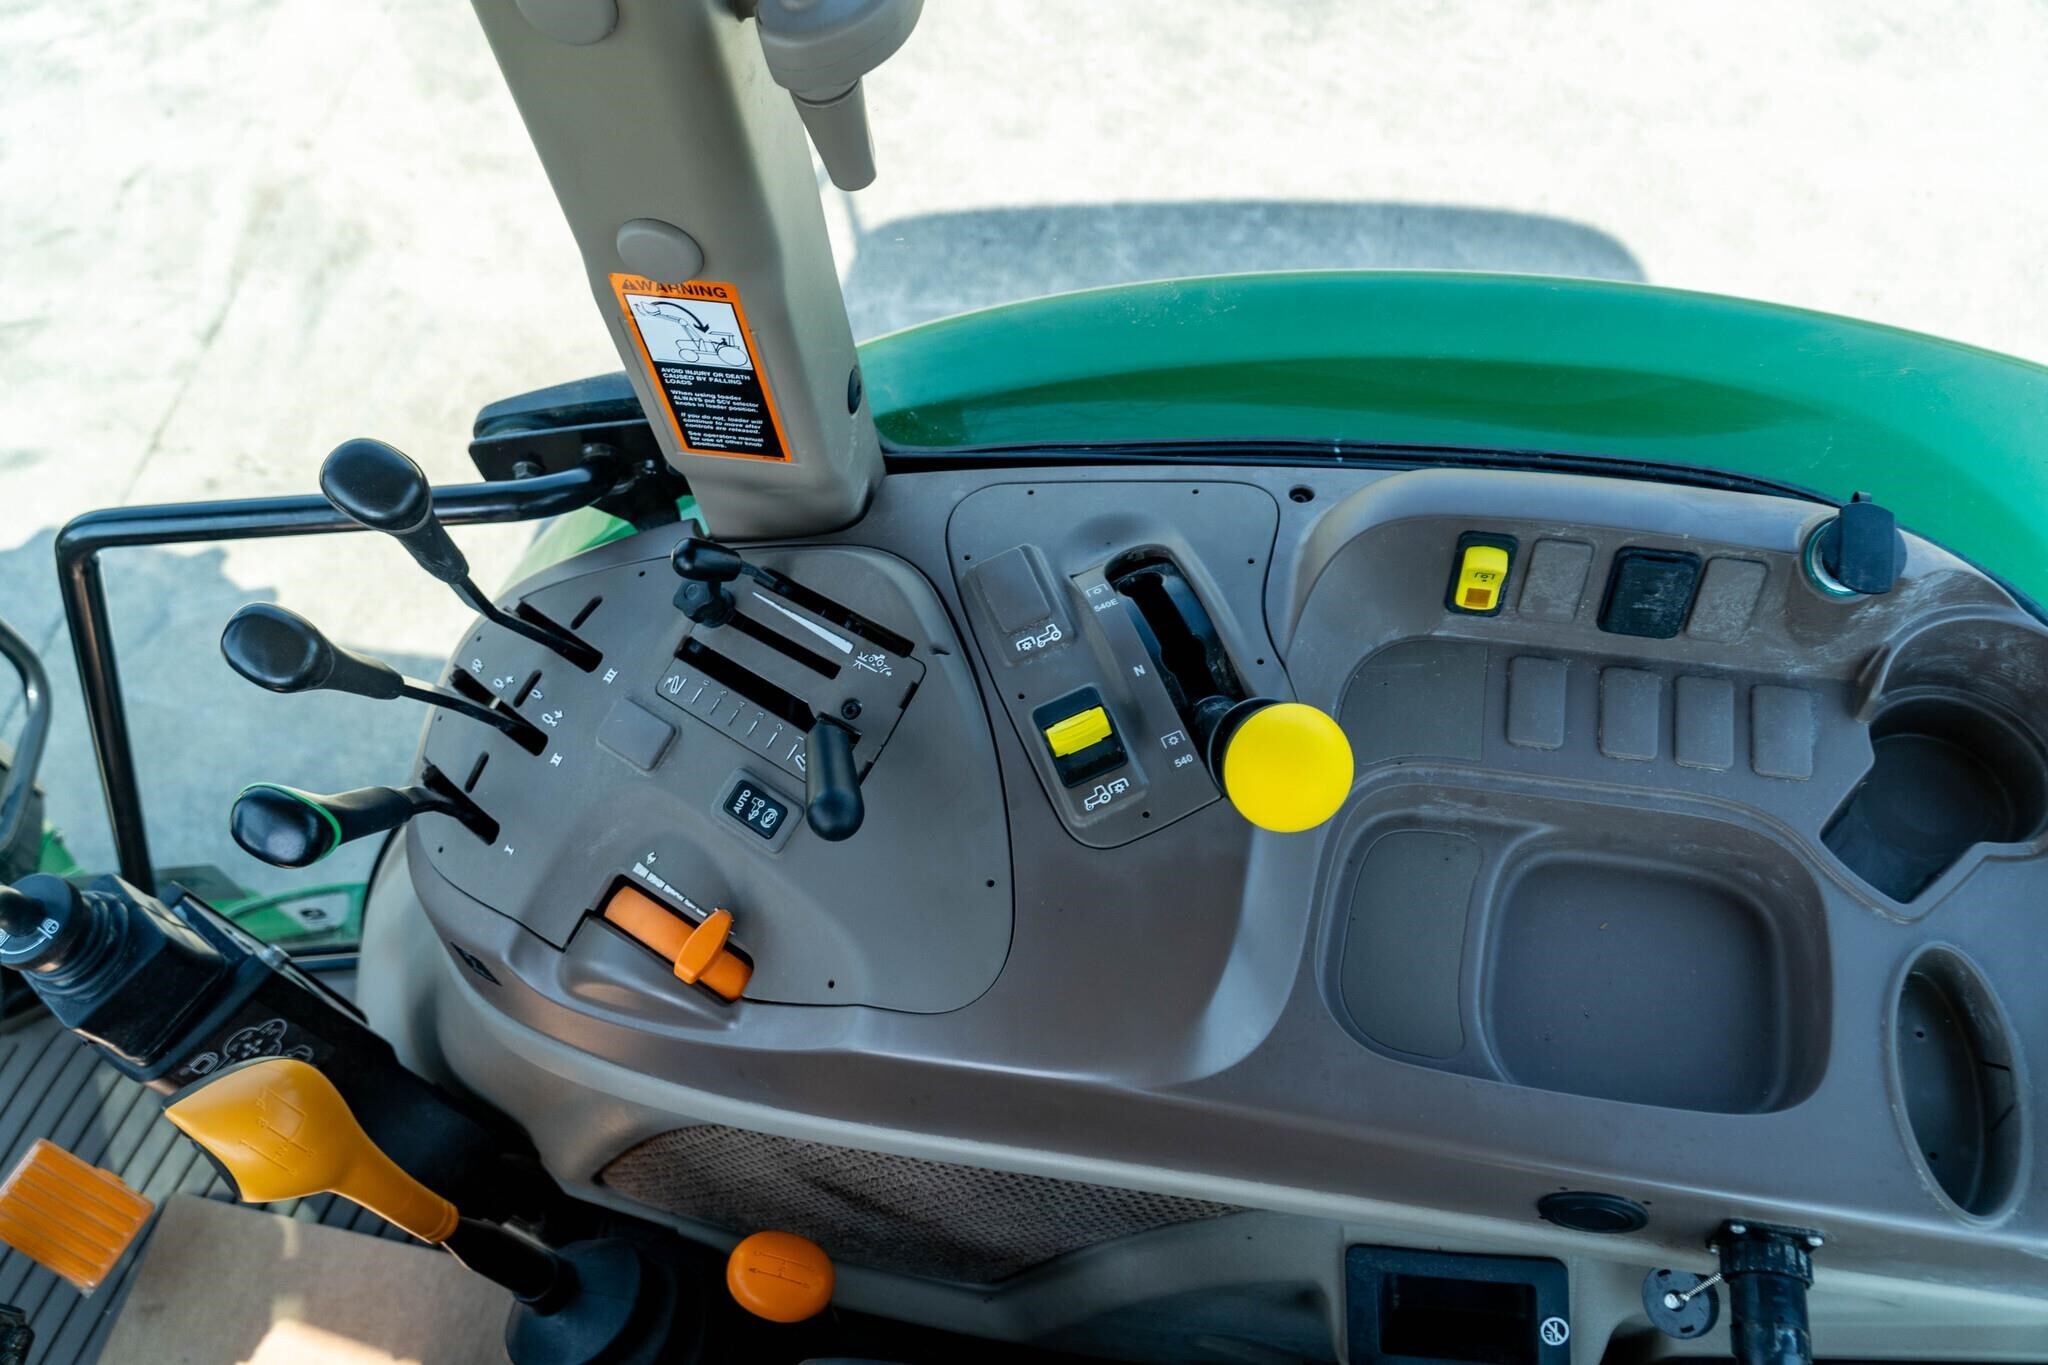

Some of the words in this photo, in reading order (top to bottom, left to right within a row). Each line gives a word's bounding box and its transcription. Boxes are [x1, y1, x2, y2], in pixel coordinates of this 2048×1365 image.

[636, 280, 728, 298] WARNING
[1093, 598, 1119, 612] 540E
[1132, 664, 1146, 677] N
[776, 722, 784, 731] 2
[1174, 754, 1194, 768] 540
[732, 789, 752, 814] AUTO
